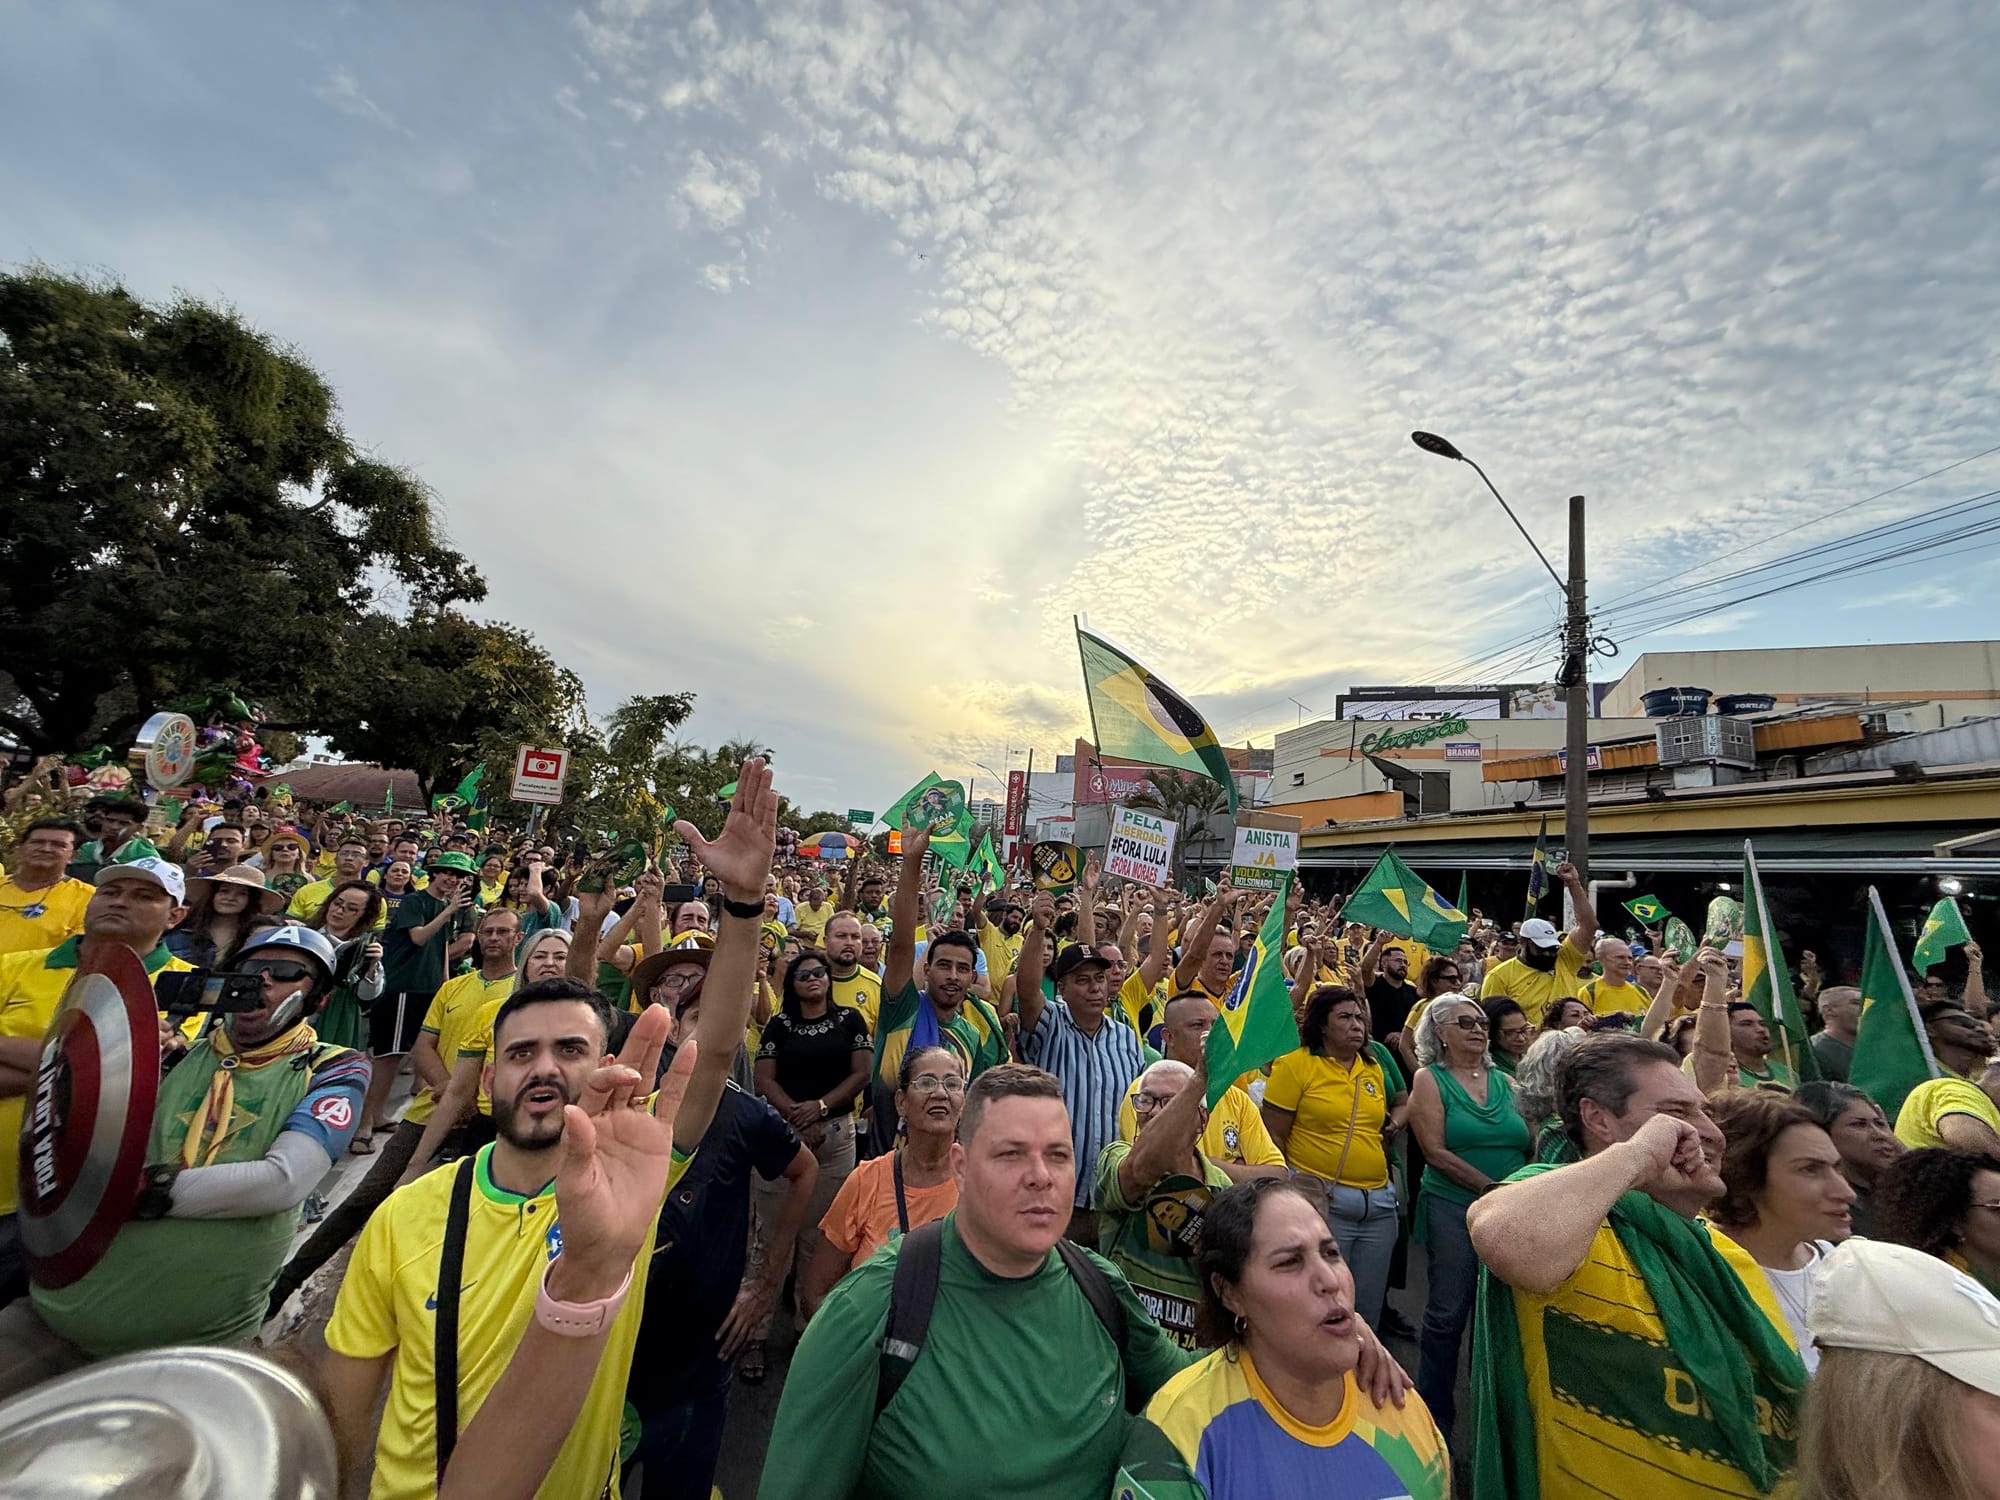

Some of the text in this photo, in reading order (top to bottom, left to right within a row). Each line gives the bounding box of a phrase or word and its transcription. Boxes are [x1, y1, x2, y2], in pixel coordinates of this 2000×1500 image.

[1446, 748, 1480, 758] BRAHMA
[1123, 811, 1163, 833] PELA
[1115, 823, 1168, 847] LIBERDADE
[1244, 829, 1290, 849] ANISTIA
[1111, 836, 1168, 868] #FORA LULA
[1252, 849, 1277, 868] JÁ
[1110, 856, 1159, 884] #FORA MORAES
[1235, 867, 1261, 879] VOLTA
[1234, 876, 1273, 889] BOLSONARO
[33, 1132, 58, 1200] FORA
[1165, 1299, 1195, 1329] LULA!
[1181, 1332, 1198, 1350] JÁ
